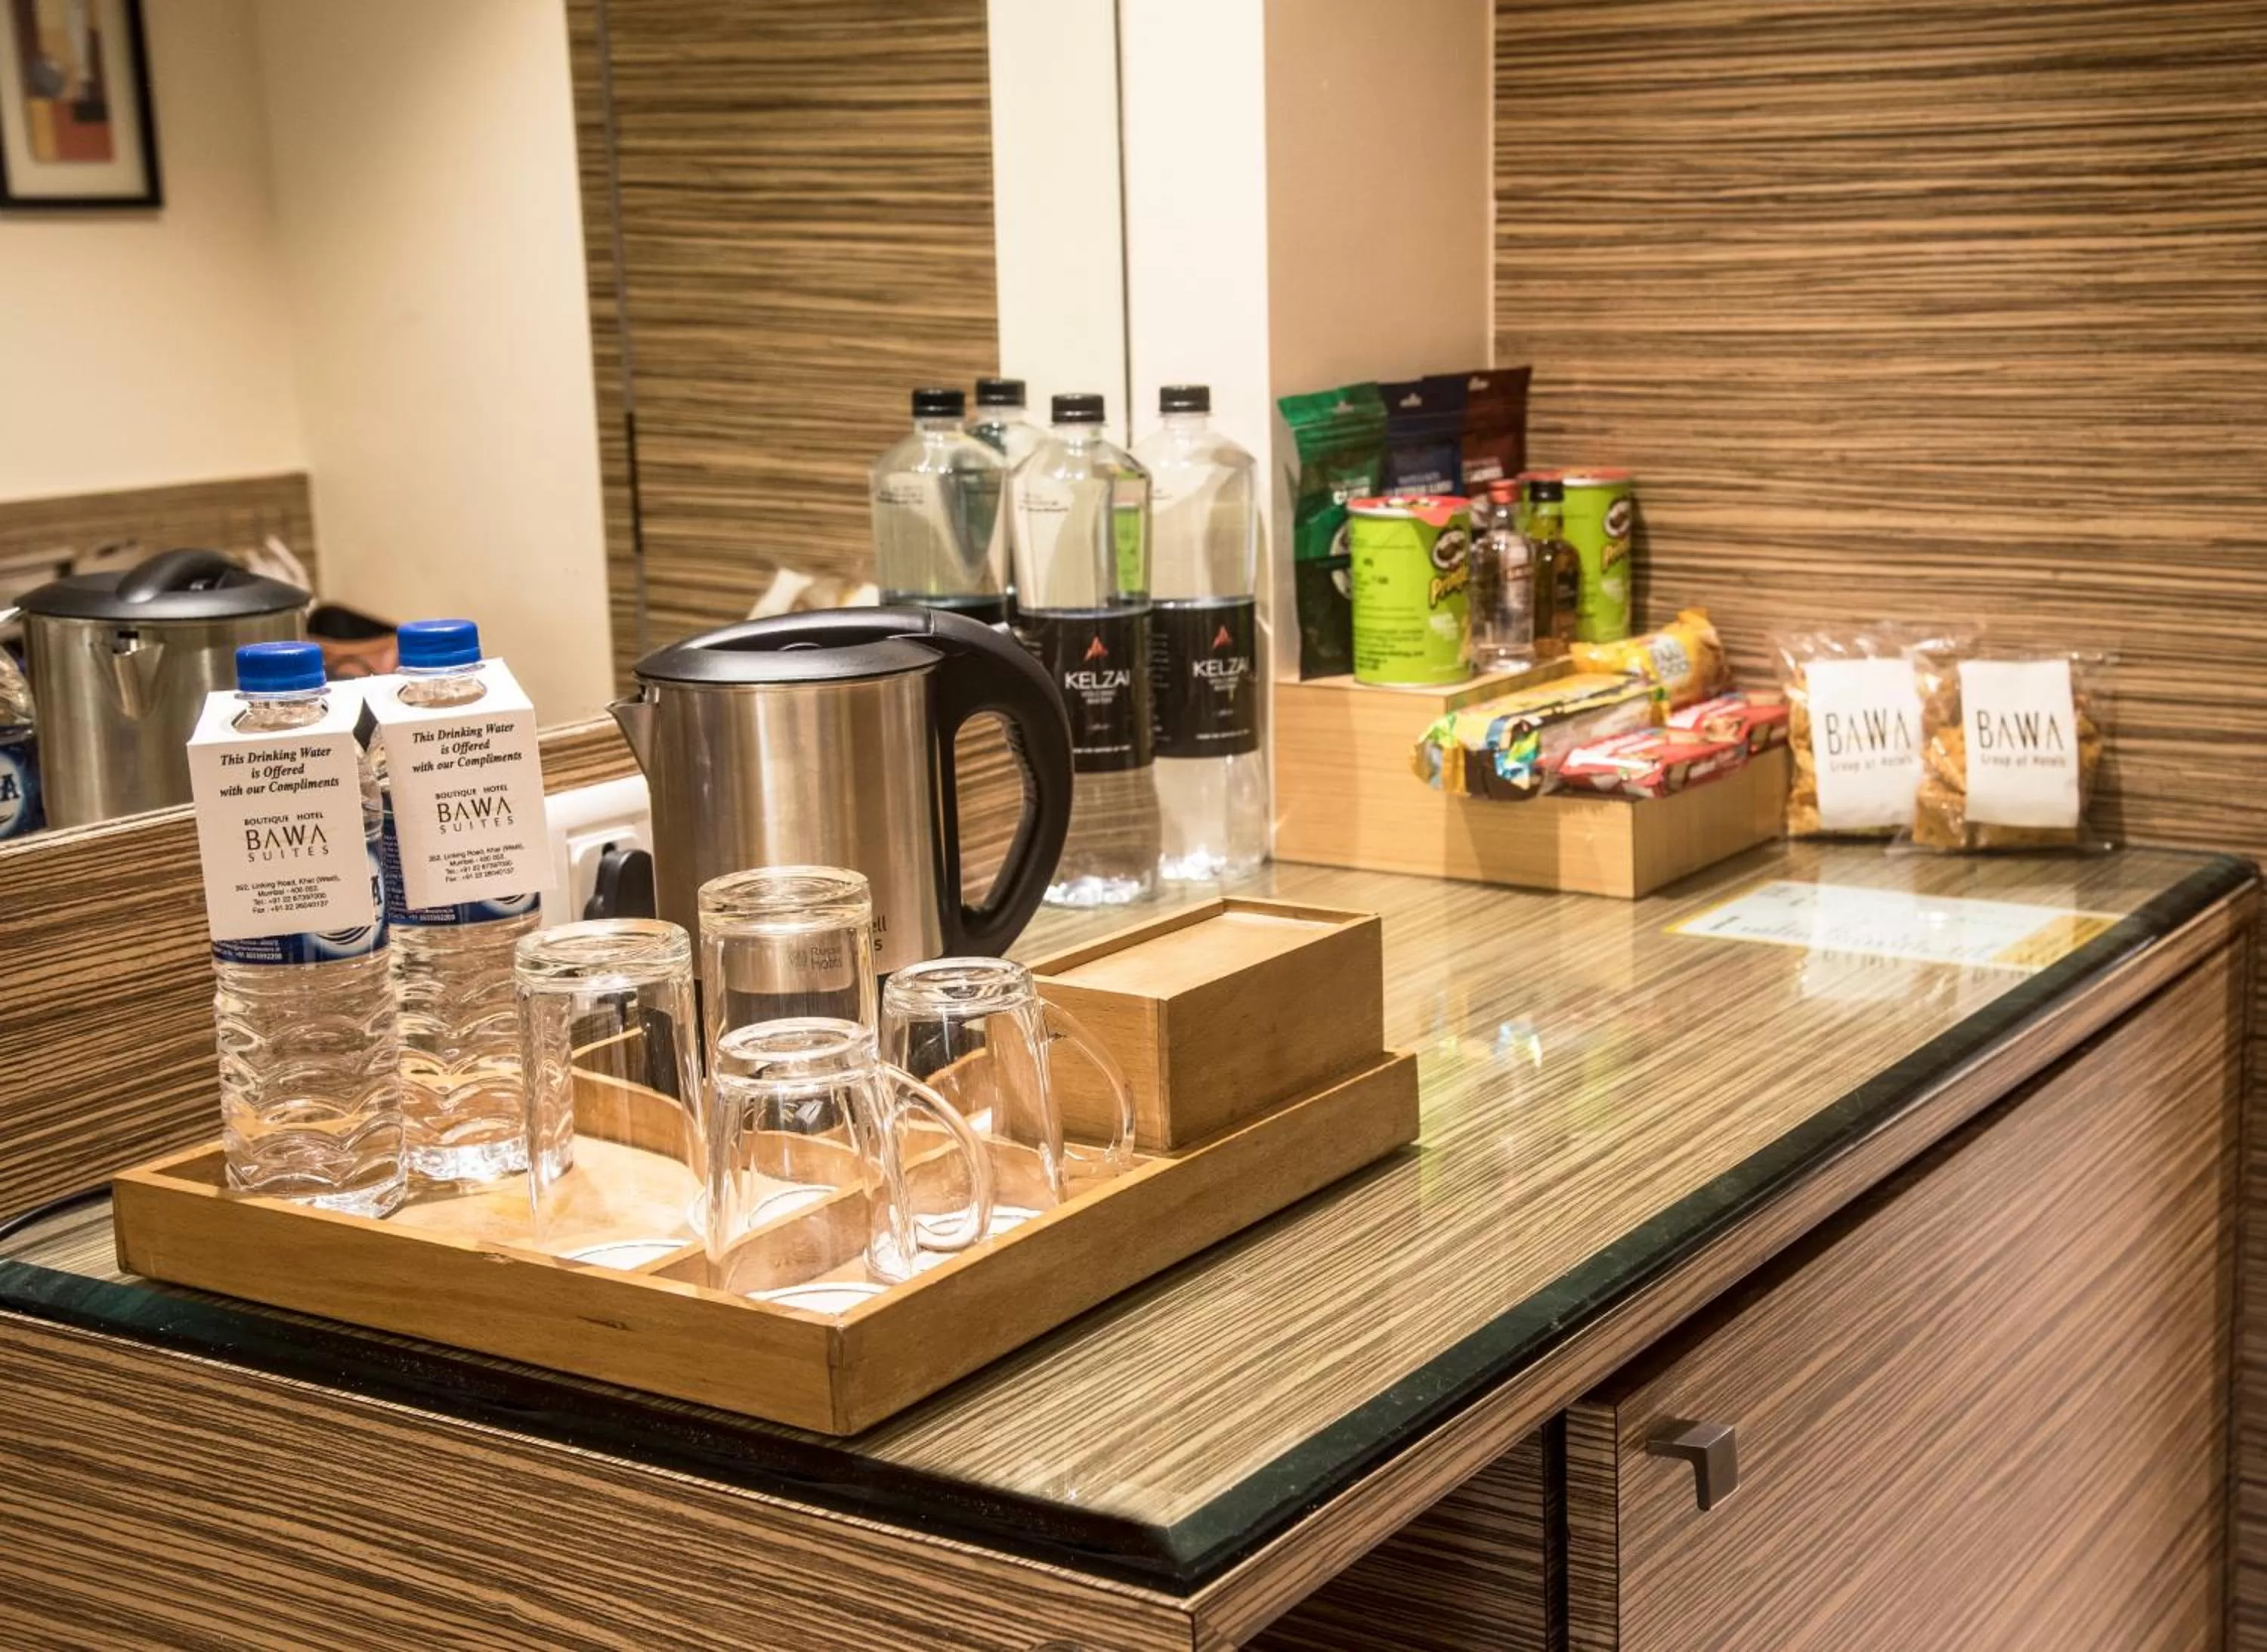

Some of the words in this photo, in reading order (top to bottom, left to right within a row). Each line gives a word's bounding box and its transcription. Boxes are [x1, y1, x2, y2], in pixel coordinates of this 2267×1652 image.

[413, 731, 435, 744] This
[437, 727, 483, 741] Drinking
[486, 723, 515, 734] Water
[1826, 707, 1912, 755] BAWA
[1977, 710, 2064, 750] BAWA
[220, 753, 244, 766] This
[247, 750, 297, 763] Drinking
[300, 747, 332, 758] Water
[441, 744, 449, 754] is
[452, 739, 490, 755] Offered
[251, 768, 260, 778] is
[263, 763, 305, 780] Offered
[412, 761, 434, 772] with
[437, 761, 454, 769] our
[457, 752, 522, 768] Compliments
[220, 784, 243, 797] with
[246, 785, 265, 794] our
[269, 777, 339, 794] Compliments
[435, 788, 476, 800] BOUTIQUE
[484, 784, 508, 793] HOTEL
[244, 815, 289, 826] BOUTIQUE
[296, 812, 323, 821] HOTEL
[438, 797, 512, 823] BAWA
[439, 816, 513, 834] SUITES
[246, 824, 326, 850] BAWA
[248, 845, 329, 862] SUITES
